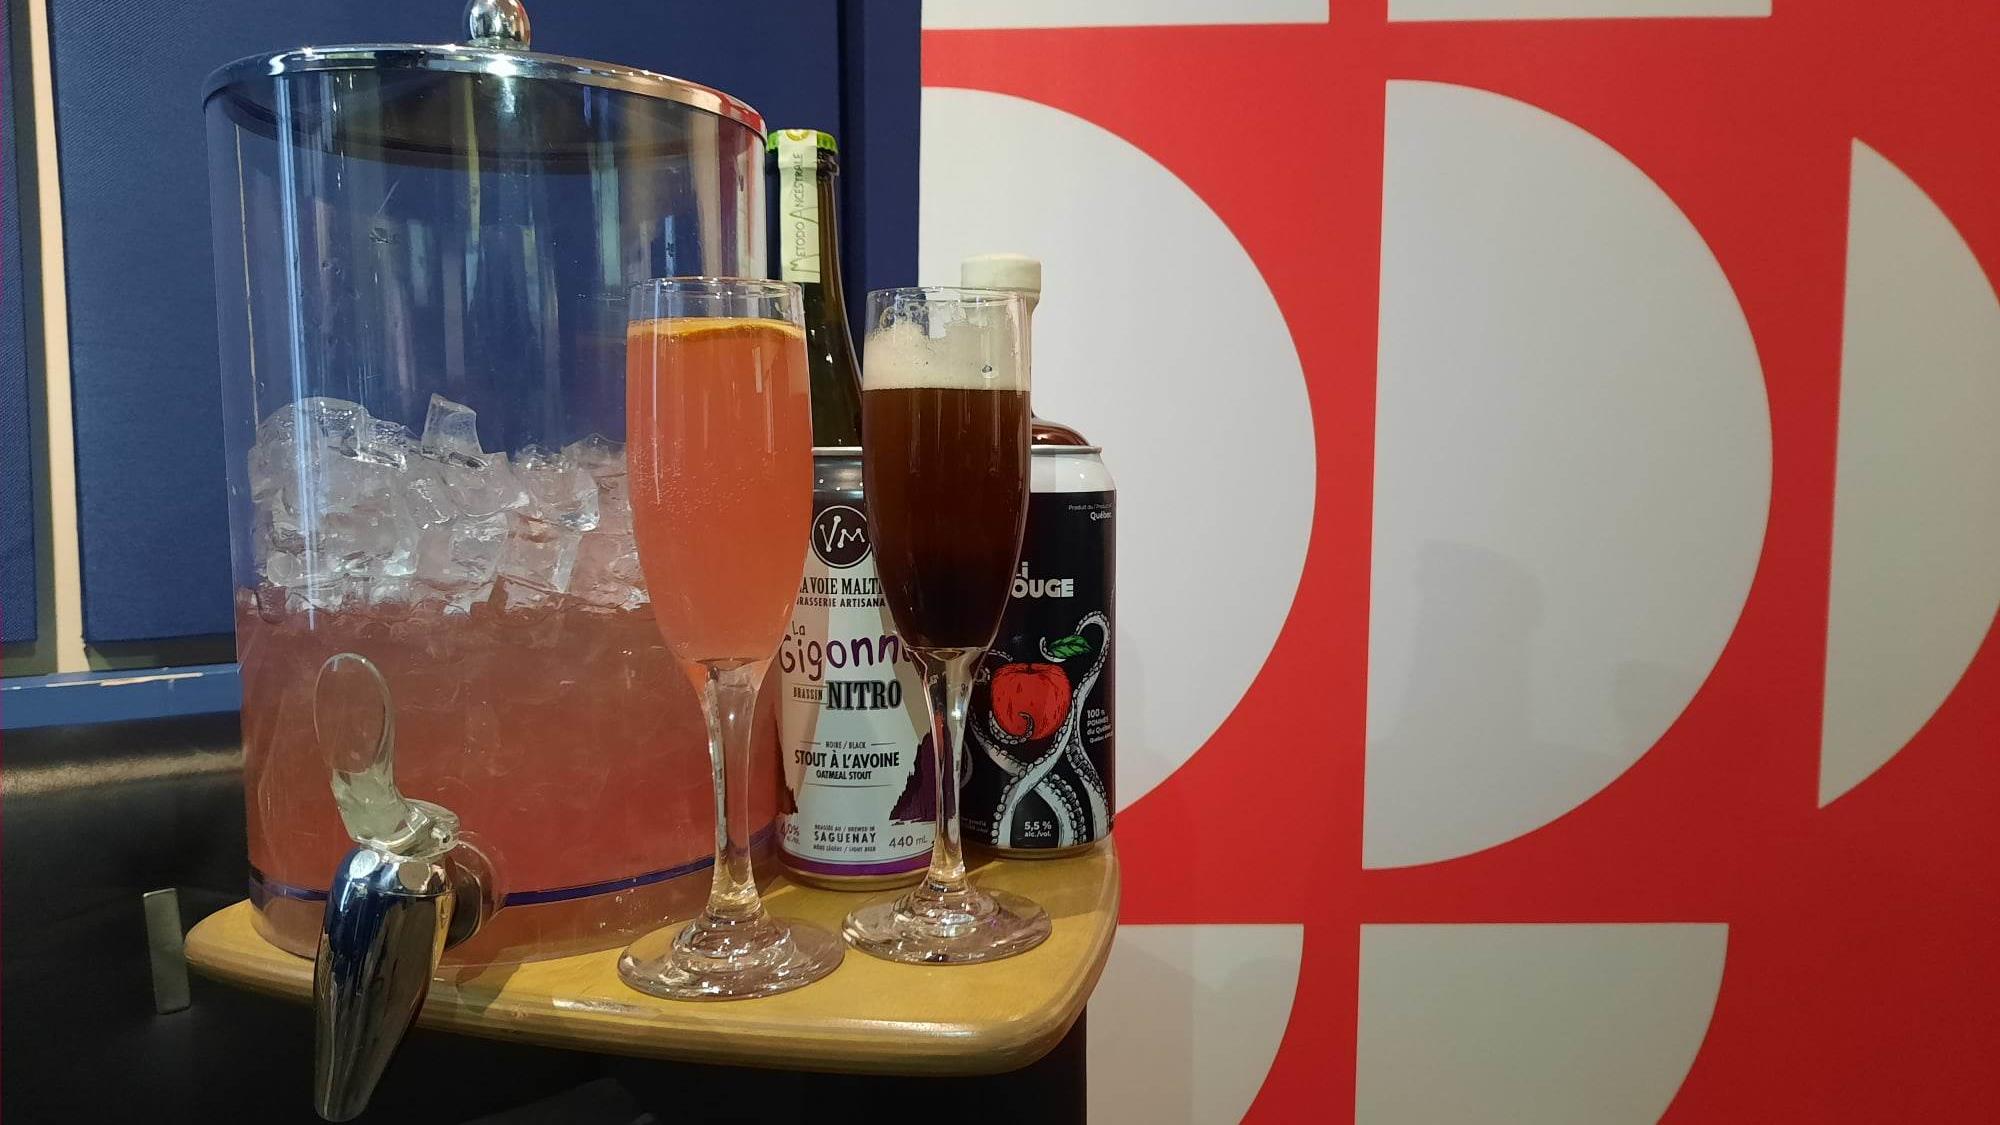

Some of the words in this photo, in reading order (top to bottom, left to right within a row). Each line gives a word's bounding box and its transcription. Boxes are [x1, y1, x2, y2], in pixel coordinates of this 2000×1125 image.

[790, 153, 818, 223] ANCESTRALE
[790, 221, 820, 274] METODO
[809, 577, 838, 594] VOIE
[1011, 578, 1074, 599] OUGE
[839, 598, 886, 608] ARTISANA
[792, 621, 806, 636] La
[793, 687, 823, 701] BRASSIN
[826, 679, 903, 711] NITRO
[1087, 708, 1100, 719] 100
[825, 741, 842, 749] NOIRE
[849, 741, 866, 750] BLACK
[795, 749, 827, 768] STOUT
[830, 749, 839, 768] À
[843, 751, 900, 769] L'AVOINE
[816, 769, 847, 780] OATMEAL
[848, 770, 872, 780] STOUT
[1024, 821, 1040, 832] 5,5
[1042, 820, 1052, 831] %
[814, 831, 876, 843] SAGUENAY
[889, 835, 914, 848] 440
[915, 834, 928, 847] mL
